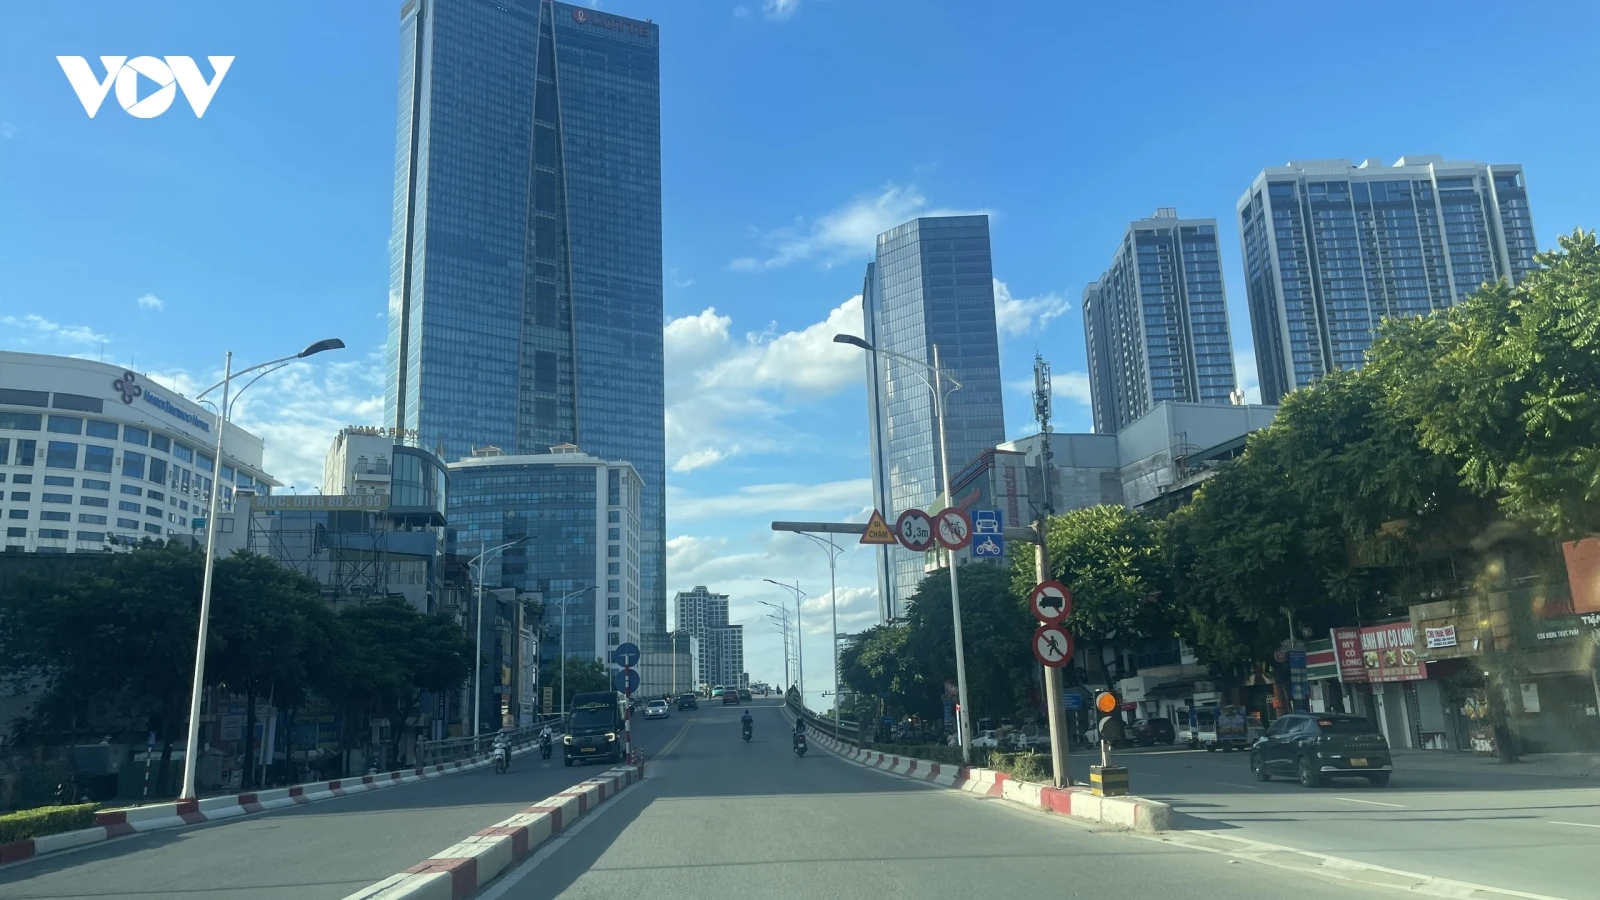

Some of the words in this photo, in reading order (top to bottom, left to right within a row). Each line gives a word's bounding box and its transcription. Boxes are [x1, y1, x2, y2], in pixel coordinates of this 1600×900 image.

[593, 15, 649, 37] LOTTE
[389, 427, 419, 438] BNK
[294, 496, 324, 507] 0916
[328, 496, 343, 507] 80
[347, 496, 363, 507] 20
[366, 496, 381, 507] 99
[1397, 627, 1415, 646] LON
